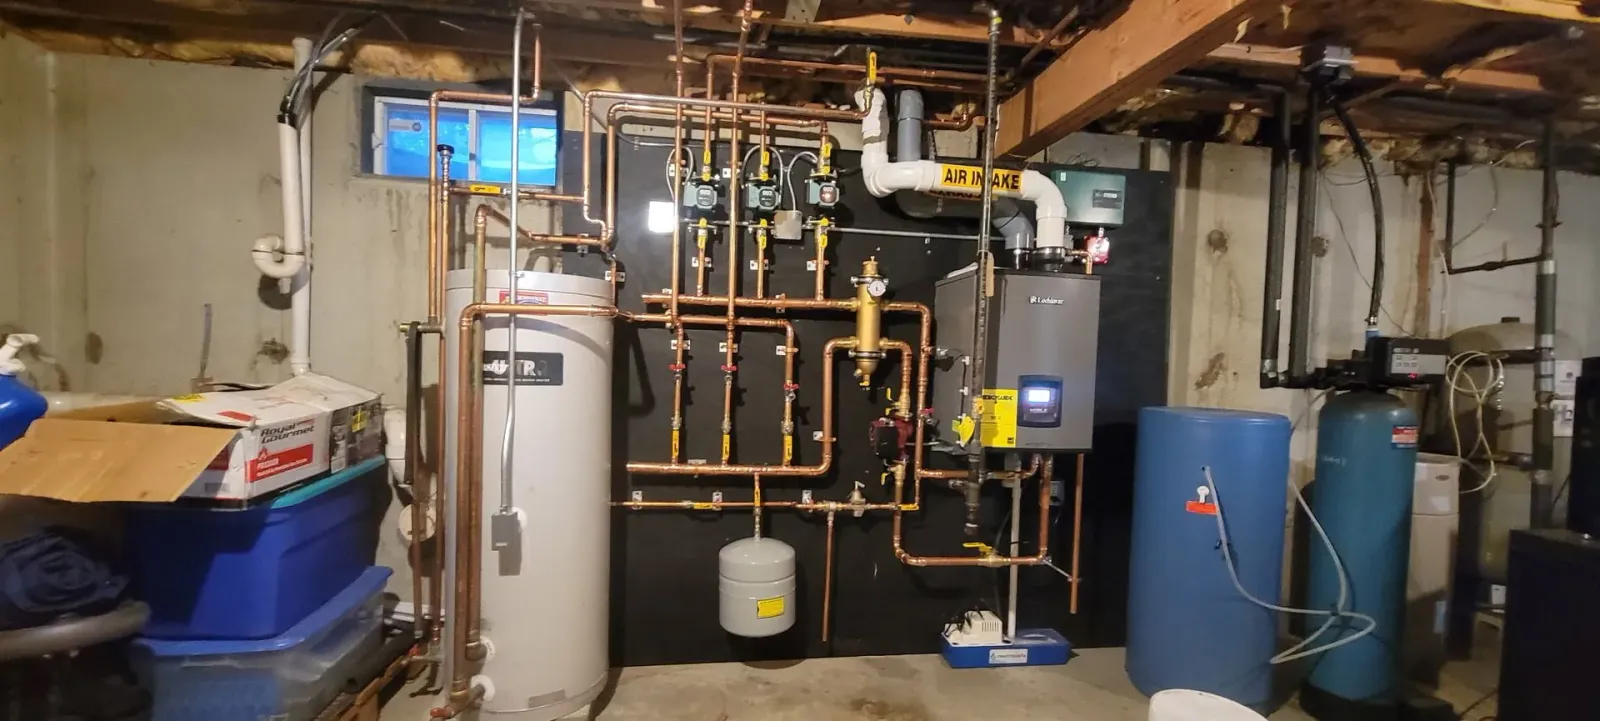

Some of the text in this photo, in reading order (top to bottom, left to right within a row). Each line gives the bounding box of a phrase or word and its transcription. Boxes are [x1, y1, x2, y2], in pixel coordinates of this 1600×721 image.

[944, 168, 1020, 189] AIR INAKE
[261, 423, 296, 437] Royal
[261, 425, 315, 444] Gourmet
